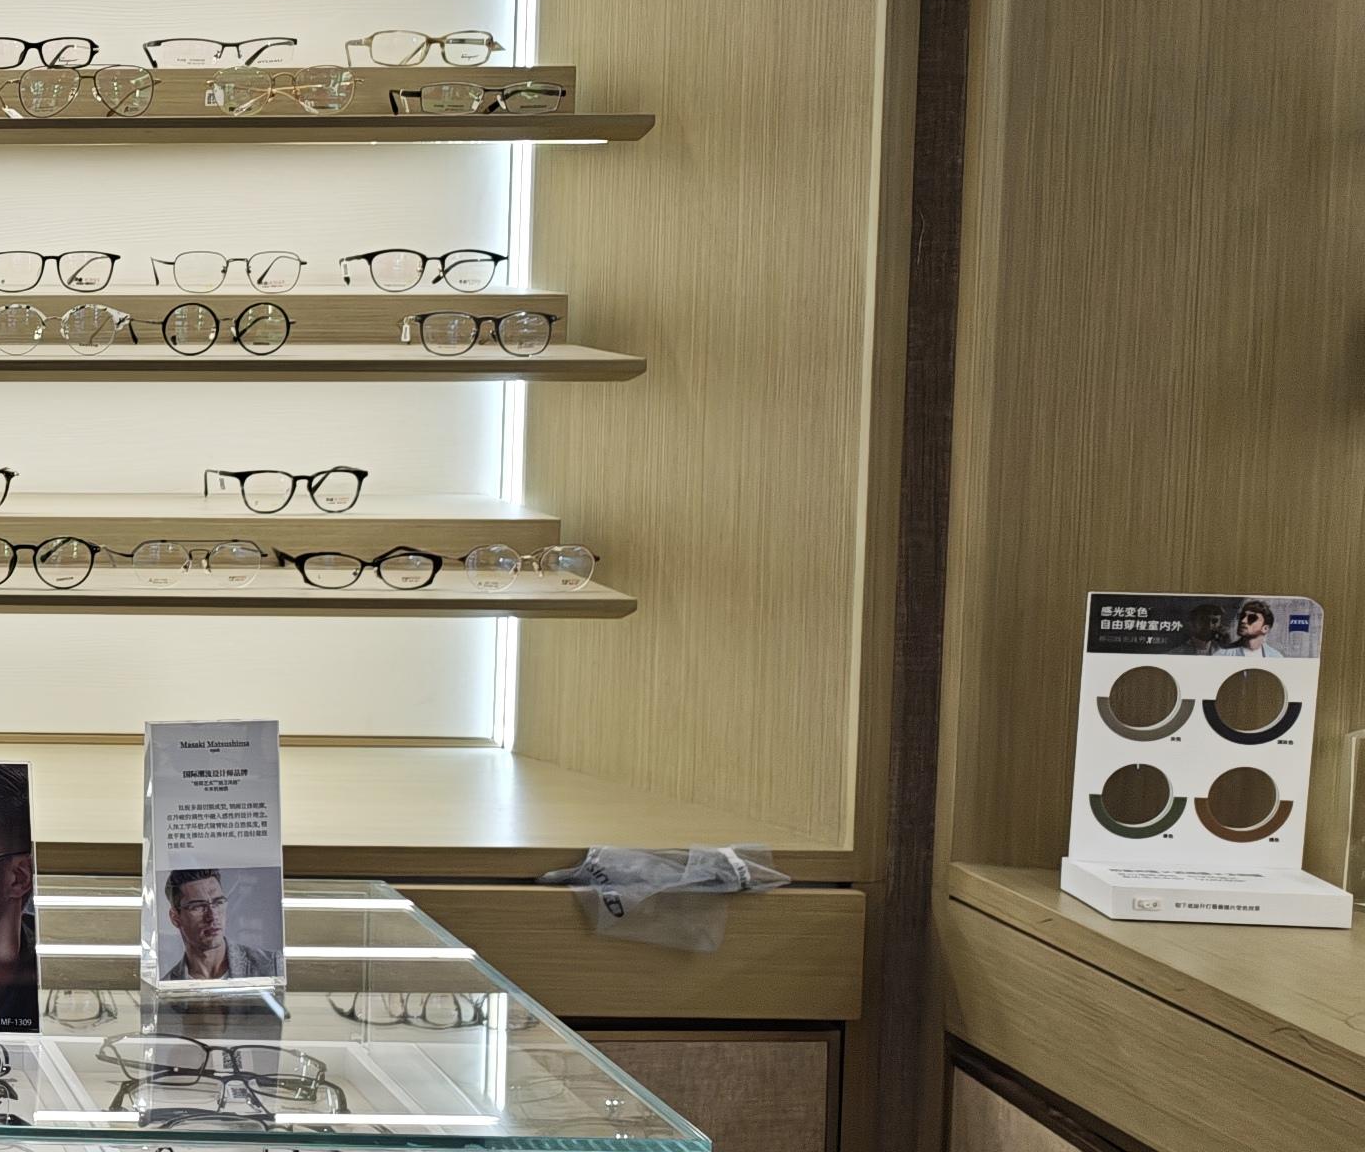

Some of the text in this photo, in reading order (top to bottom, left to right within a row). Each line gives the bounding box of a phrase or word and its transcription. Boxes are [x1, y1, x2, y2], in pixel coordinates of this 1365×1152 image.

[1101, 606, 1148, 618] 感光变色
[1101, 620, 1183, 632] 自由穿梭室内外
[207, 739, 249, 748] Matsushima
[1, 1018, 32, 1026] MF-1309
